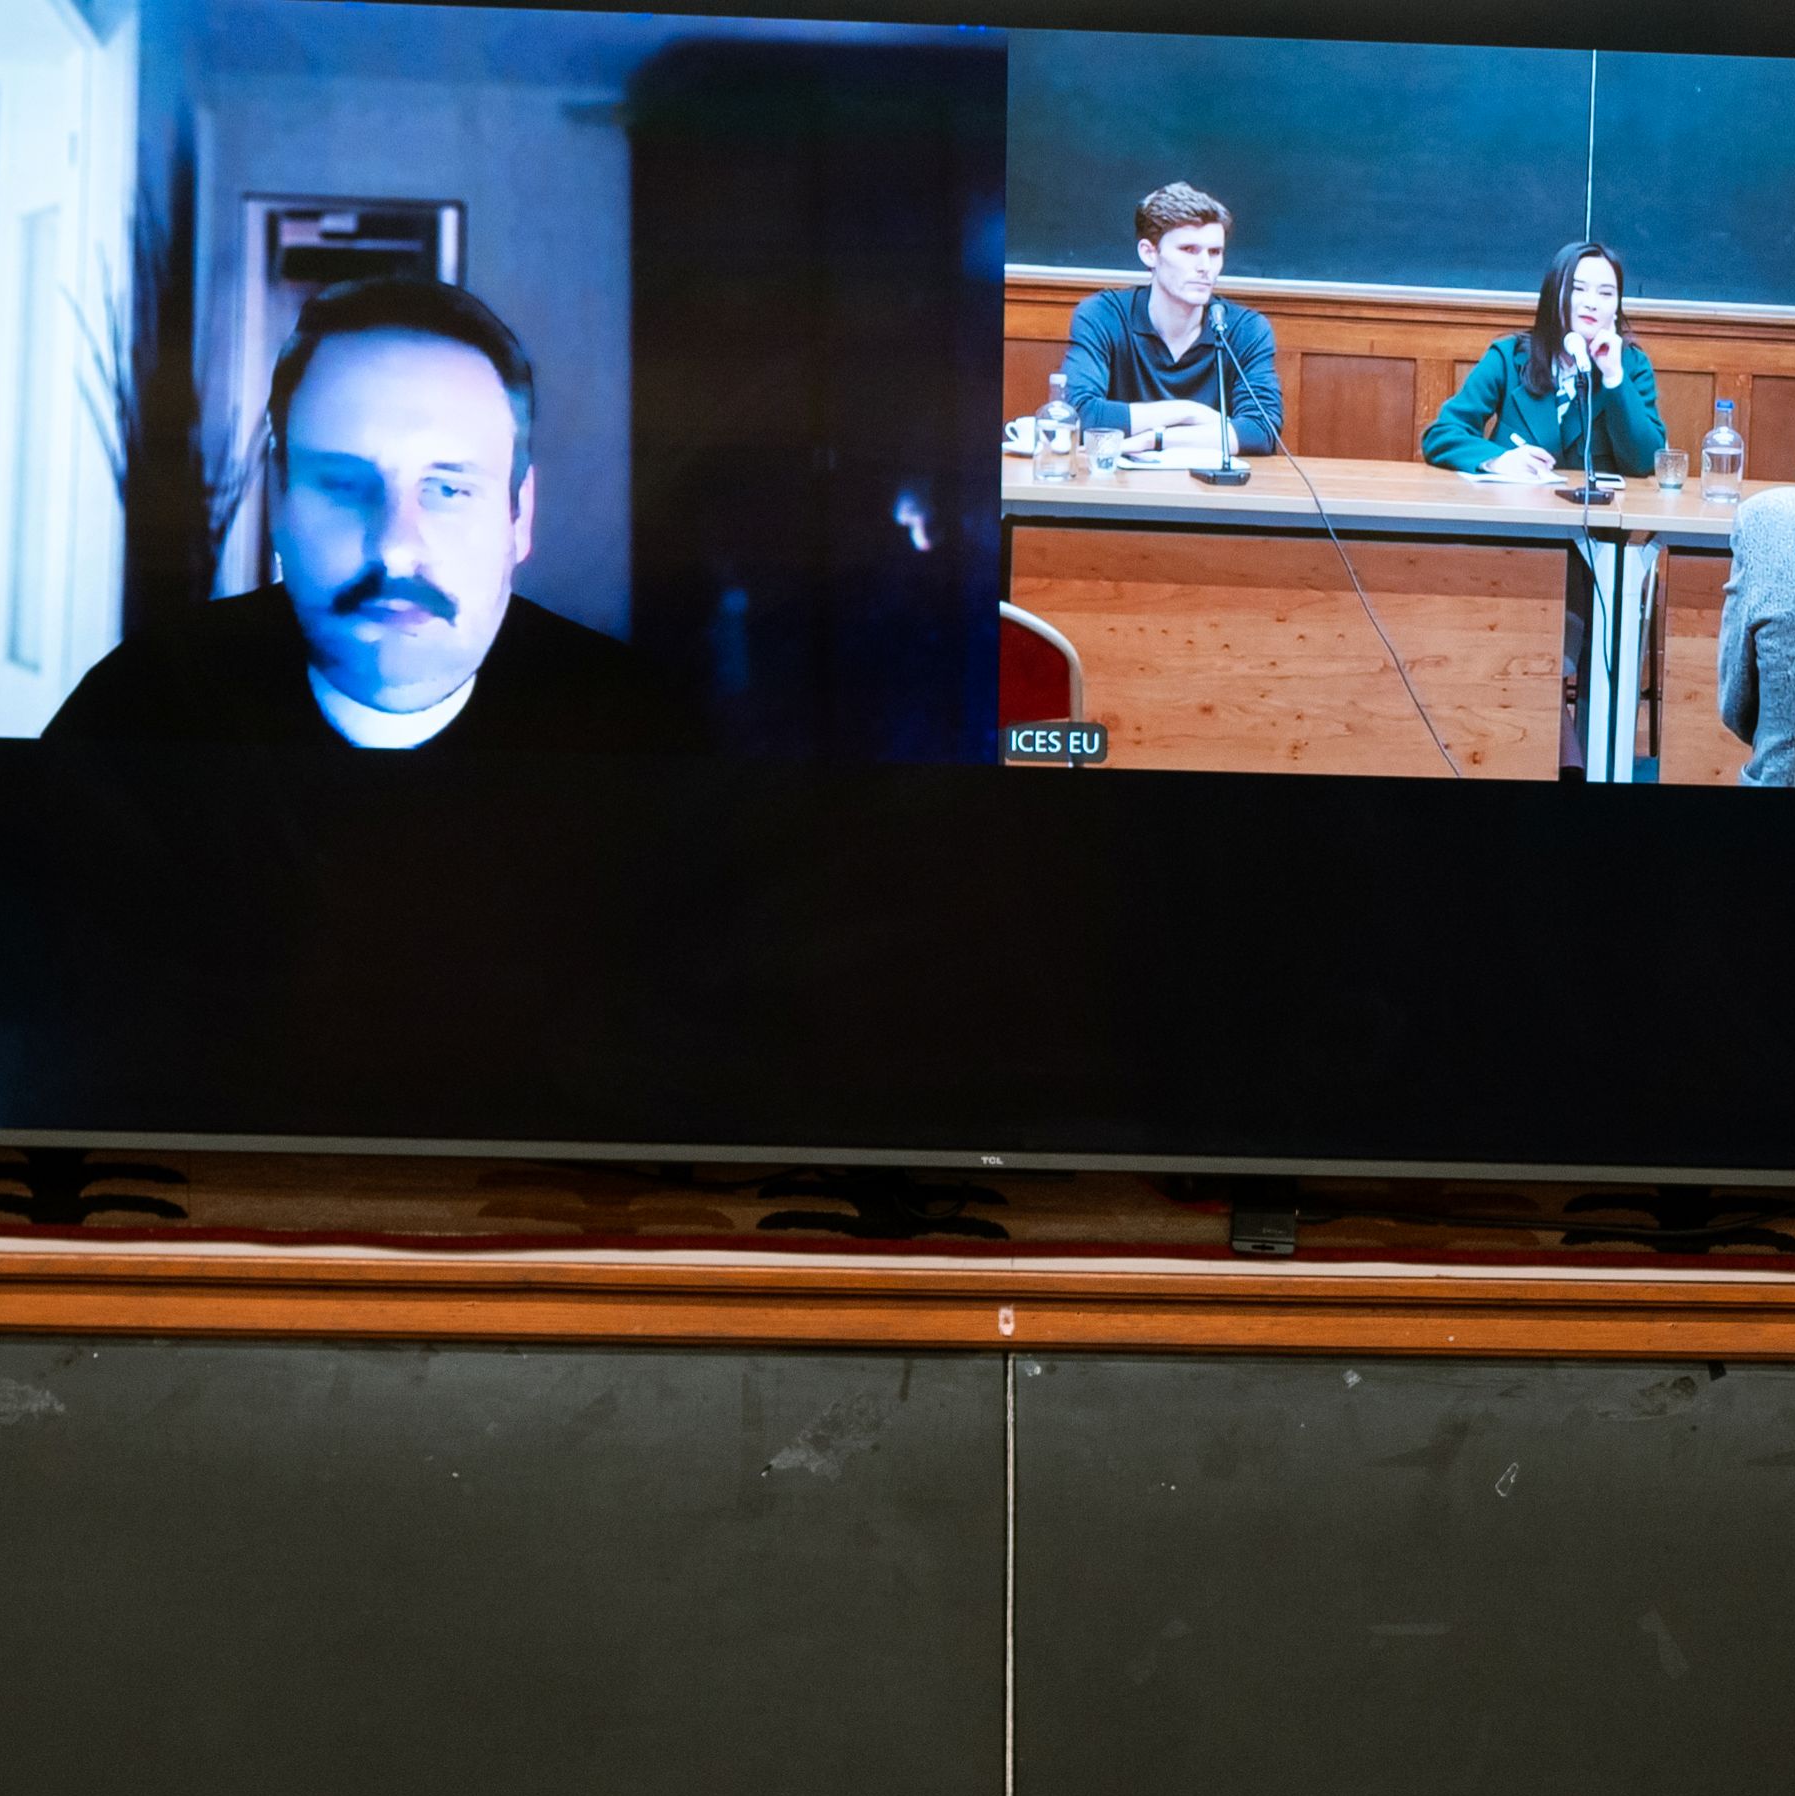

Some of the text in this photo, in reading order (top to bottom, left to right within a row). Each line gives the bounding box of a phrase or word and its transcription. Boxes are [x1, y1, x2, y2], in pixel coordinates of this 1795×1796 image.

[1011, 729, 1100, 754] ICES EU
[980, 1156, 1004, 1165] TCL
